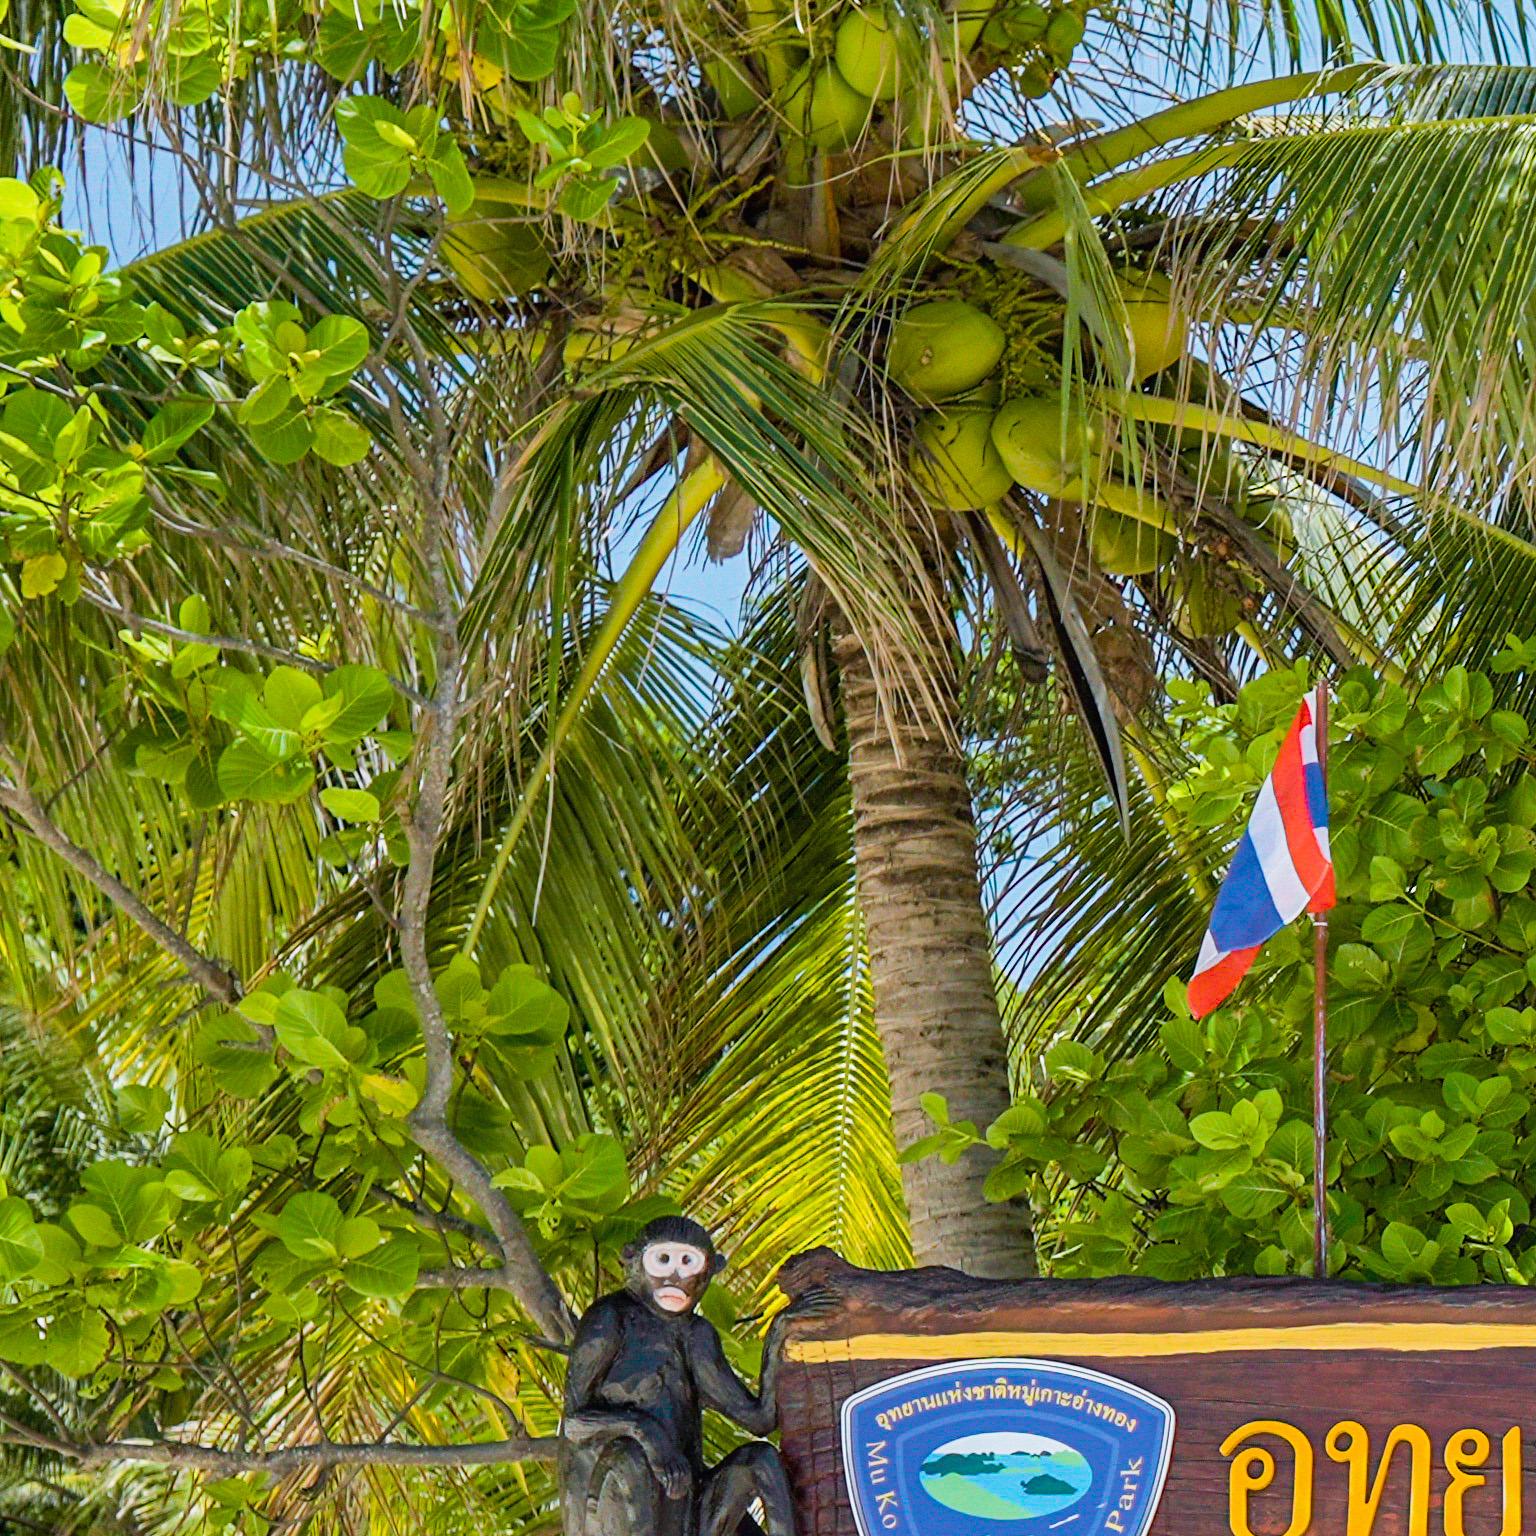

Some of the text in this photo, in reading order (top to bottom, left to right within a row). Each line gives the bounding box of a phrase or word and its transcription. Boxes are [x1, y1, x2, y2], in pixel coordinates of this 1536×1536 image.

[866, 1441, 889, 1486] Mu
[876, 1490, 898, 1530] Ko
[1105, 1455, 1144, 1534] Park
